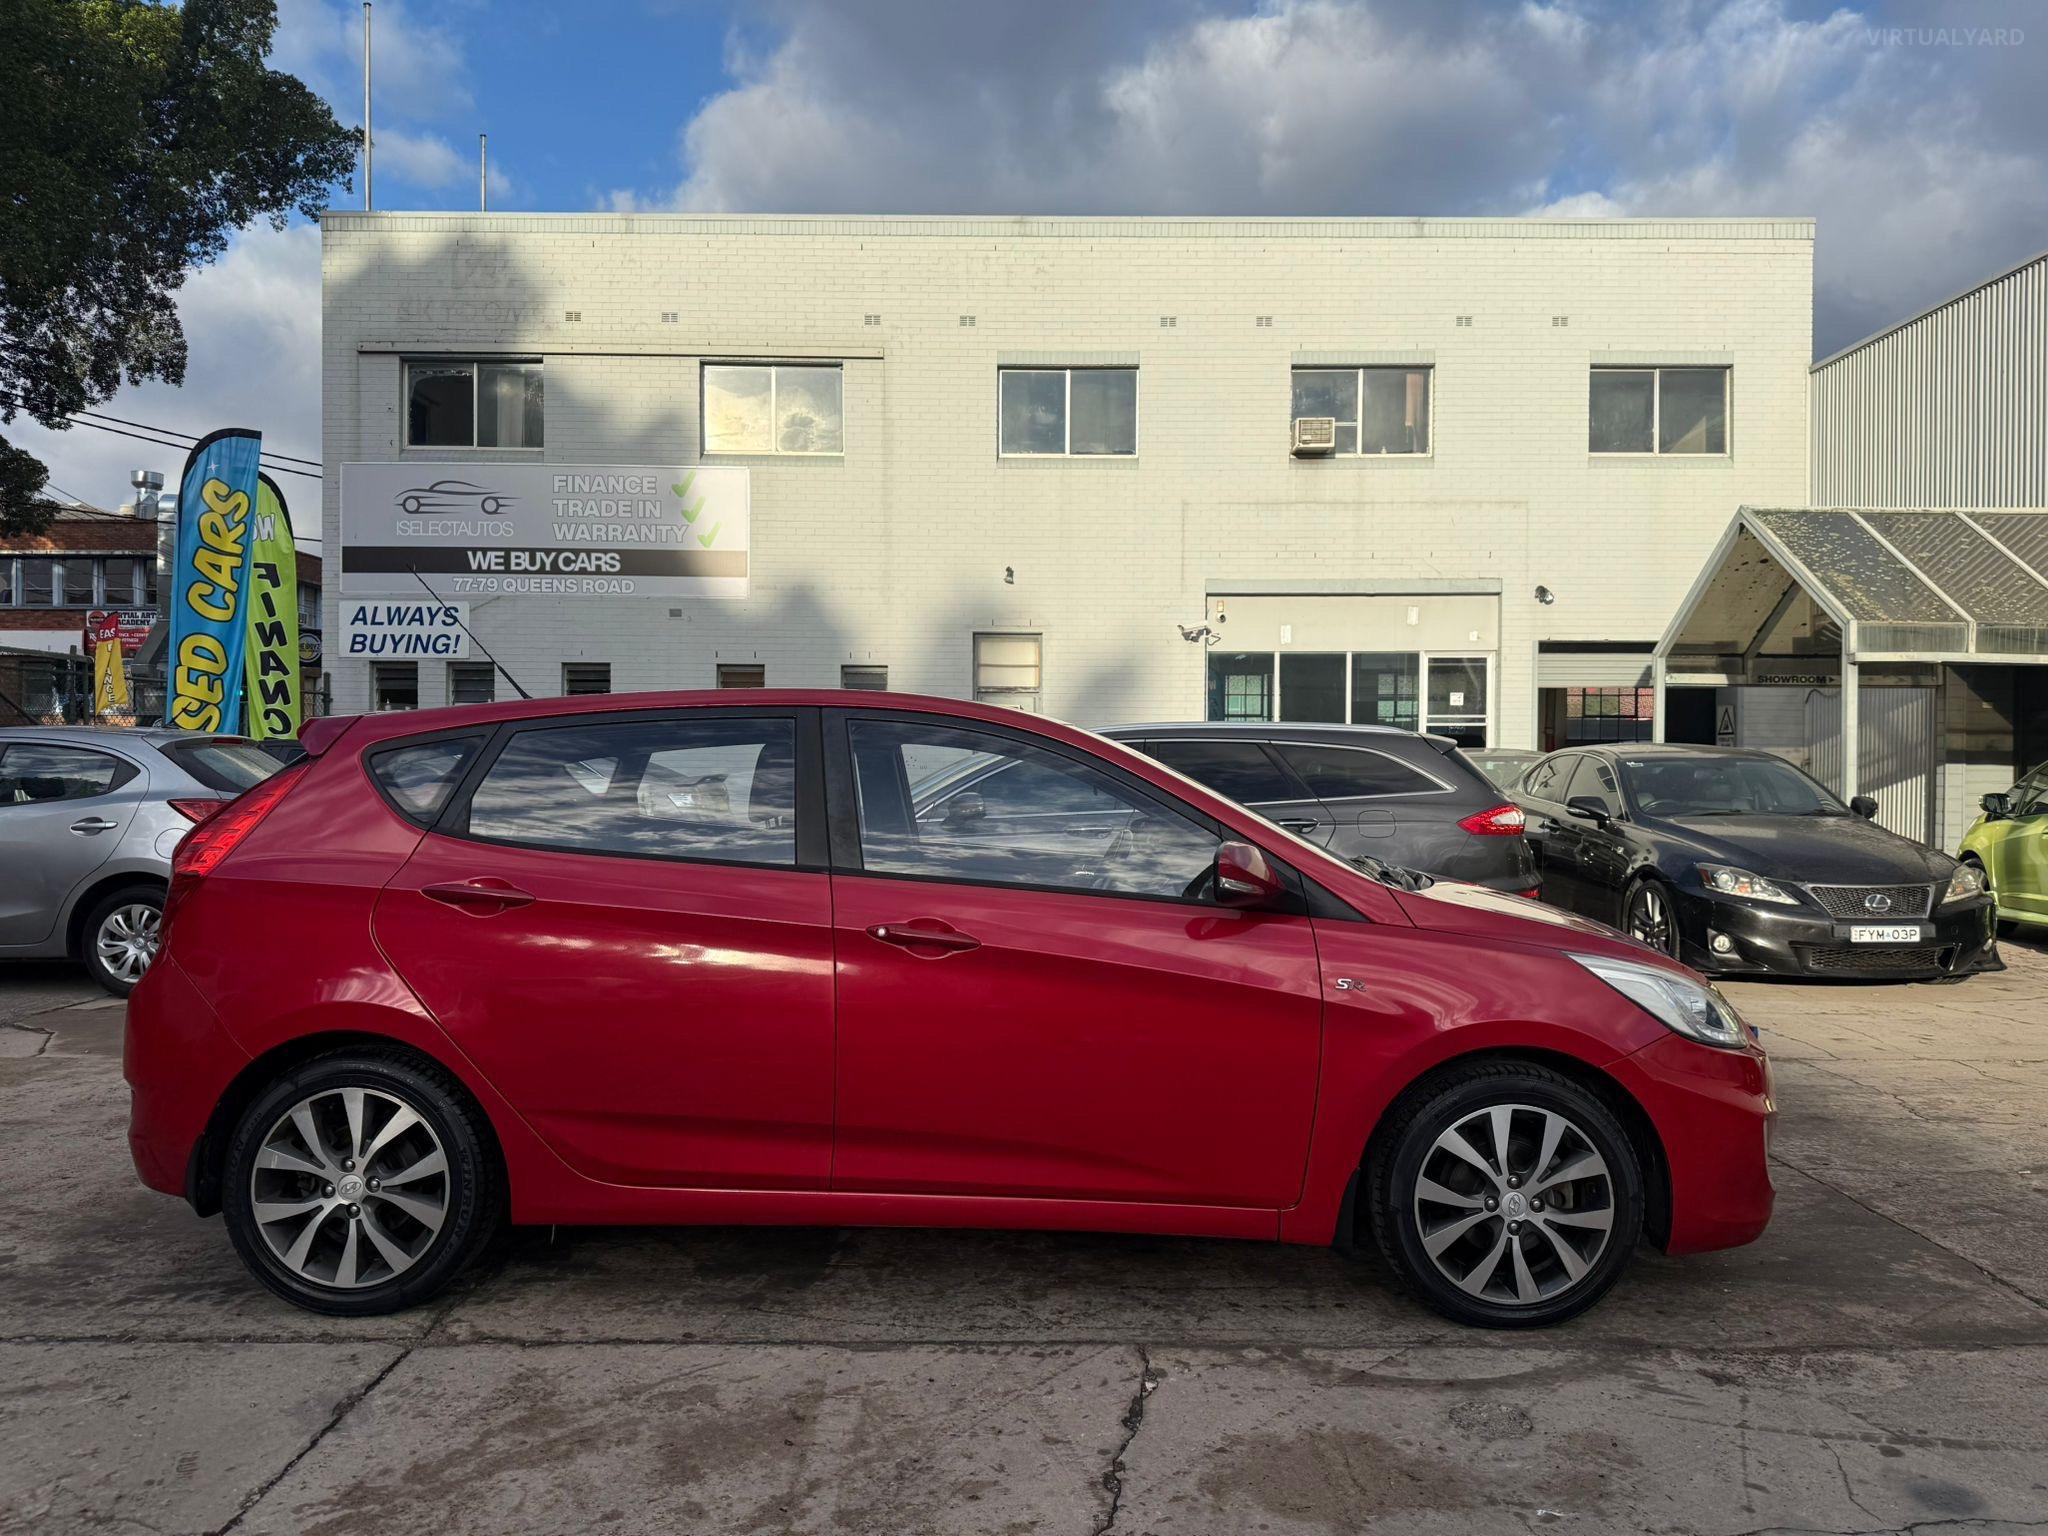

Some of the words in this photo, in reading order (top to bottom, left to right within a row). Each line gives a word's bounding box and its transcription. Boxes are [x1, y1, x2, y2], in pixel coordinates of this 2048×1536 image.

[552, 474, 658, 495] FINANCE
[552, 499, 633, 518] TRADE
[637, 500, 662, 519] IN
[396, 520, 515, 537] ISELECTAUTOS
[552, 522, 689, 543] WARRANTY
[187, 478, 250, 622] CARS
[467, 551, 505, 571] WE
[510, 551, 557, 571] BUY
[557, 552, 621, 572] CARS
[453, 577, 499, 592] 77-79
[502, 578, 578, 593] QUEENS
[581, 579, 635, 594] ROAD
[350, 606, 459, 626] ALWAYS
[100, 628, 116, 639] EAS
[349, 634, 461, 654] BUYING!
[172, 633, 229, 733] SED
[1758, 675, 1827, 684] SHOWROOM
[1859, 929, 1885, 940] FYM
